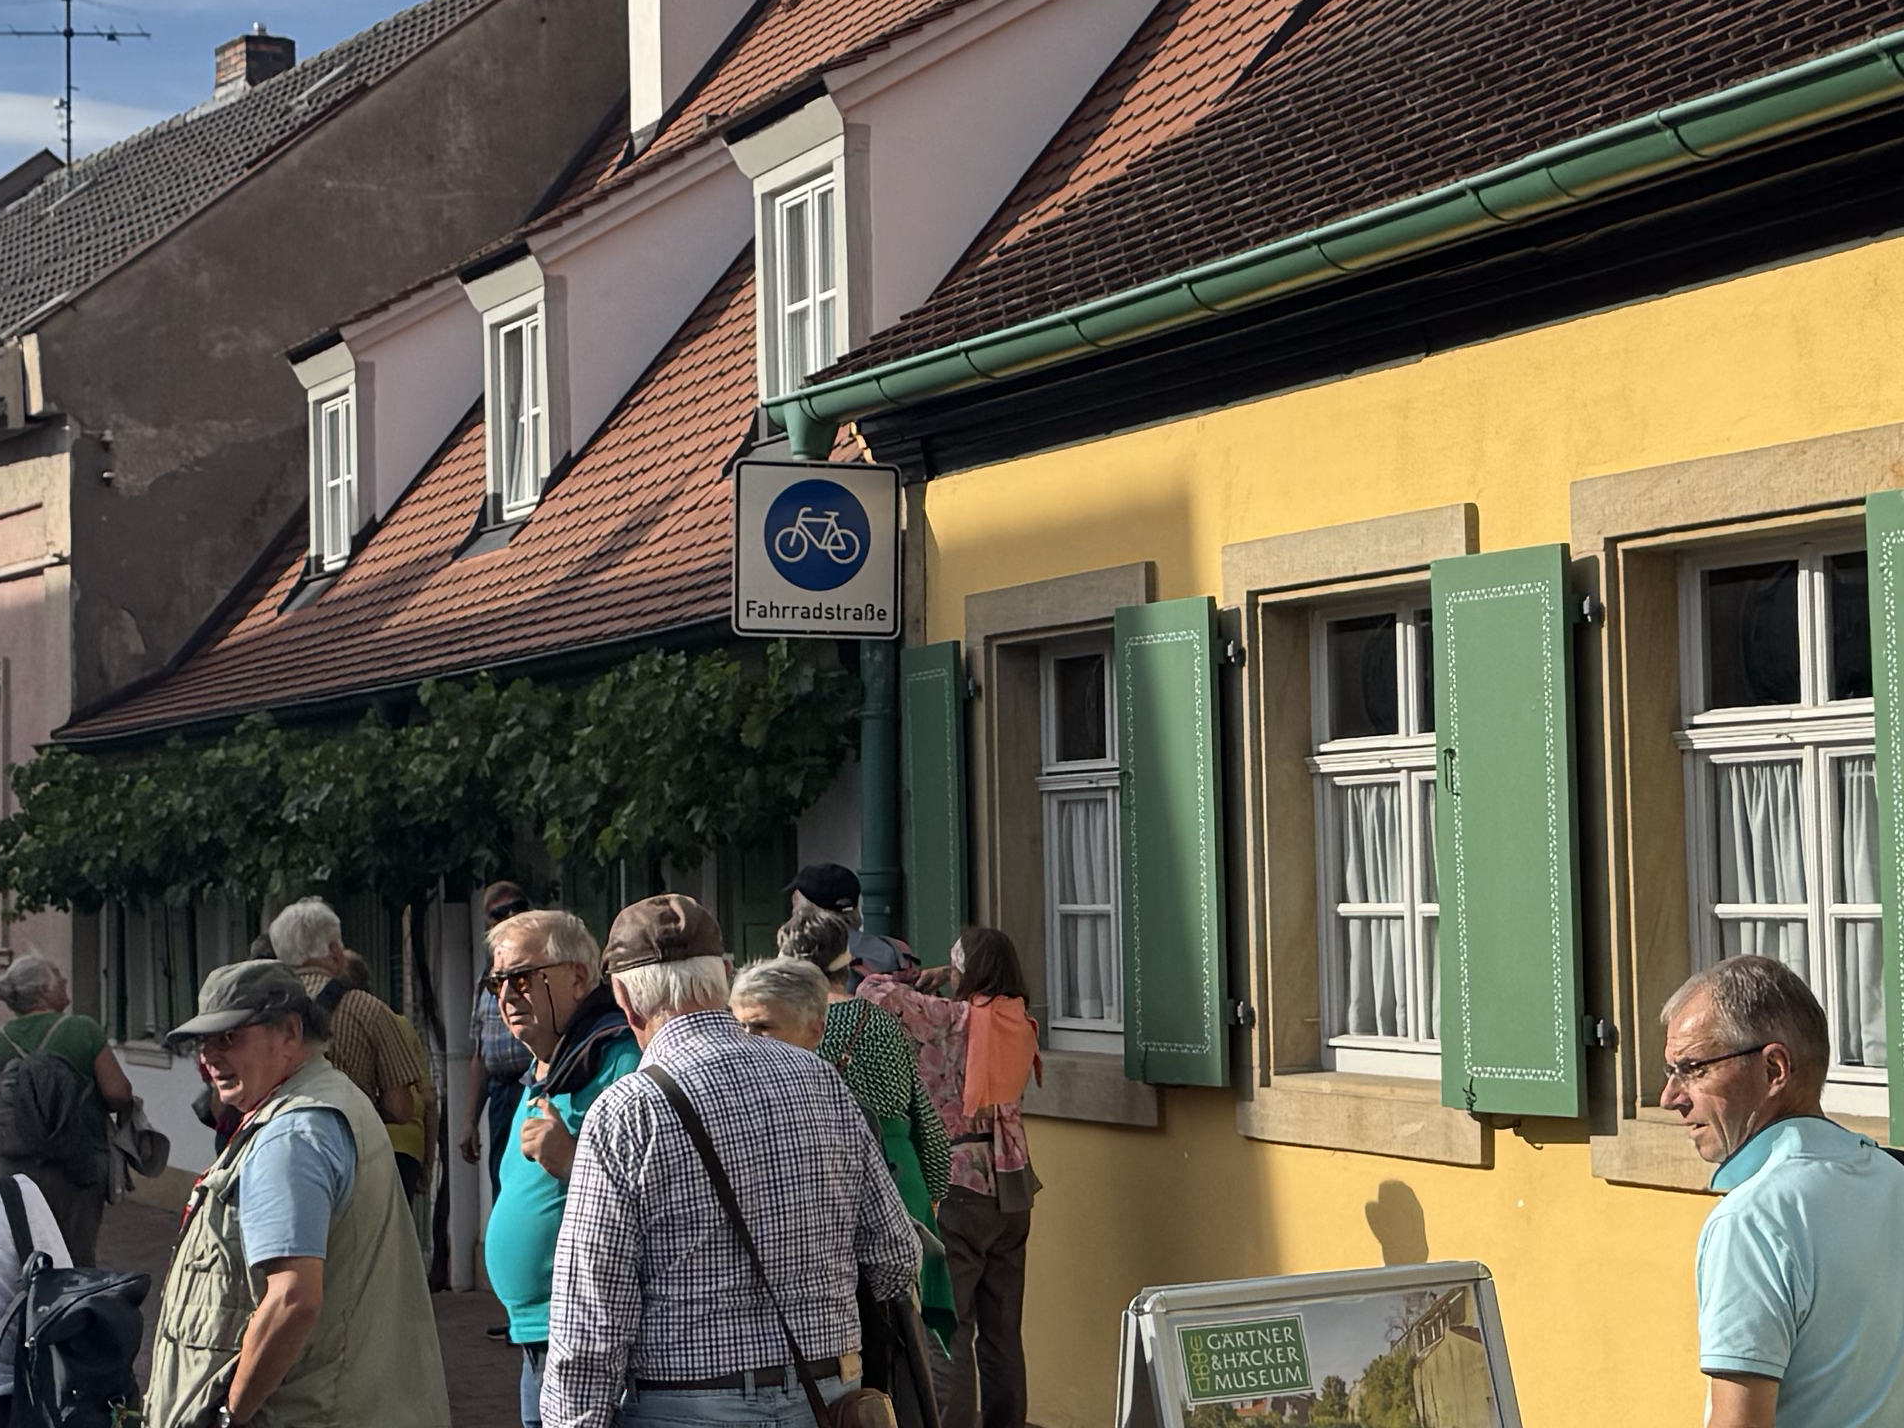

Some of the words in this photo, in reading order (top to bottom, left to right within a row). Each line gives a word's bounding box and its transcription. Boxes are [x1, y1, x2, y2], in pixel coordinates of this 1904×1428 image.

[746, 600, 887, 621] Fahrradstraße
[1206, 1325, 1296, 1351] GÄRTNER
[1215, 1365, 1304, 1391] MUSEUM
